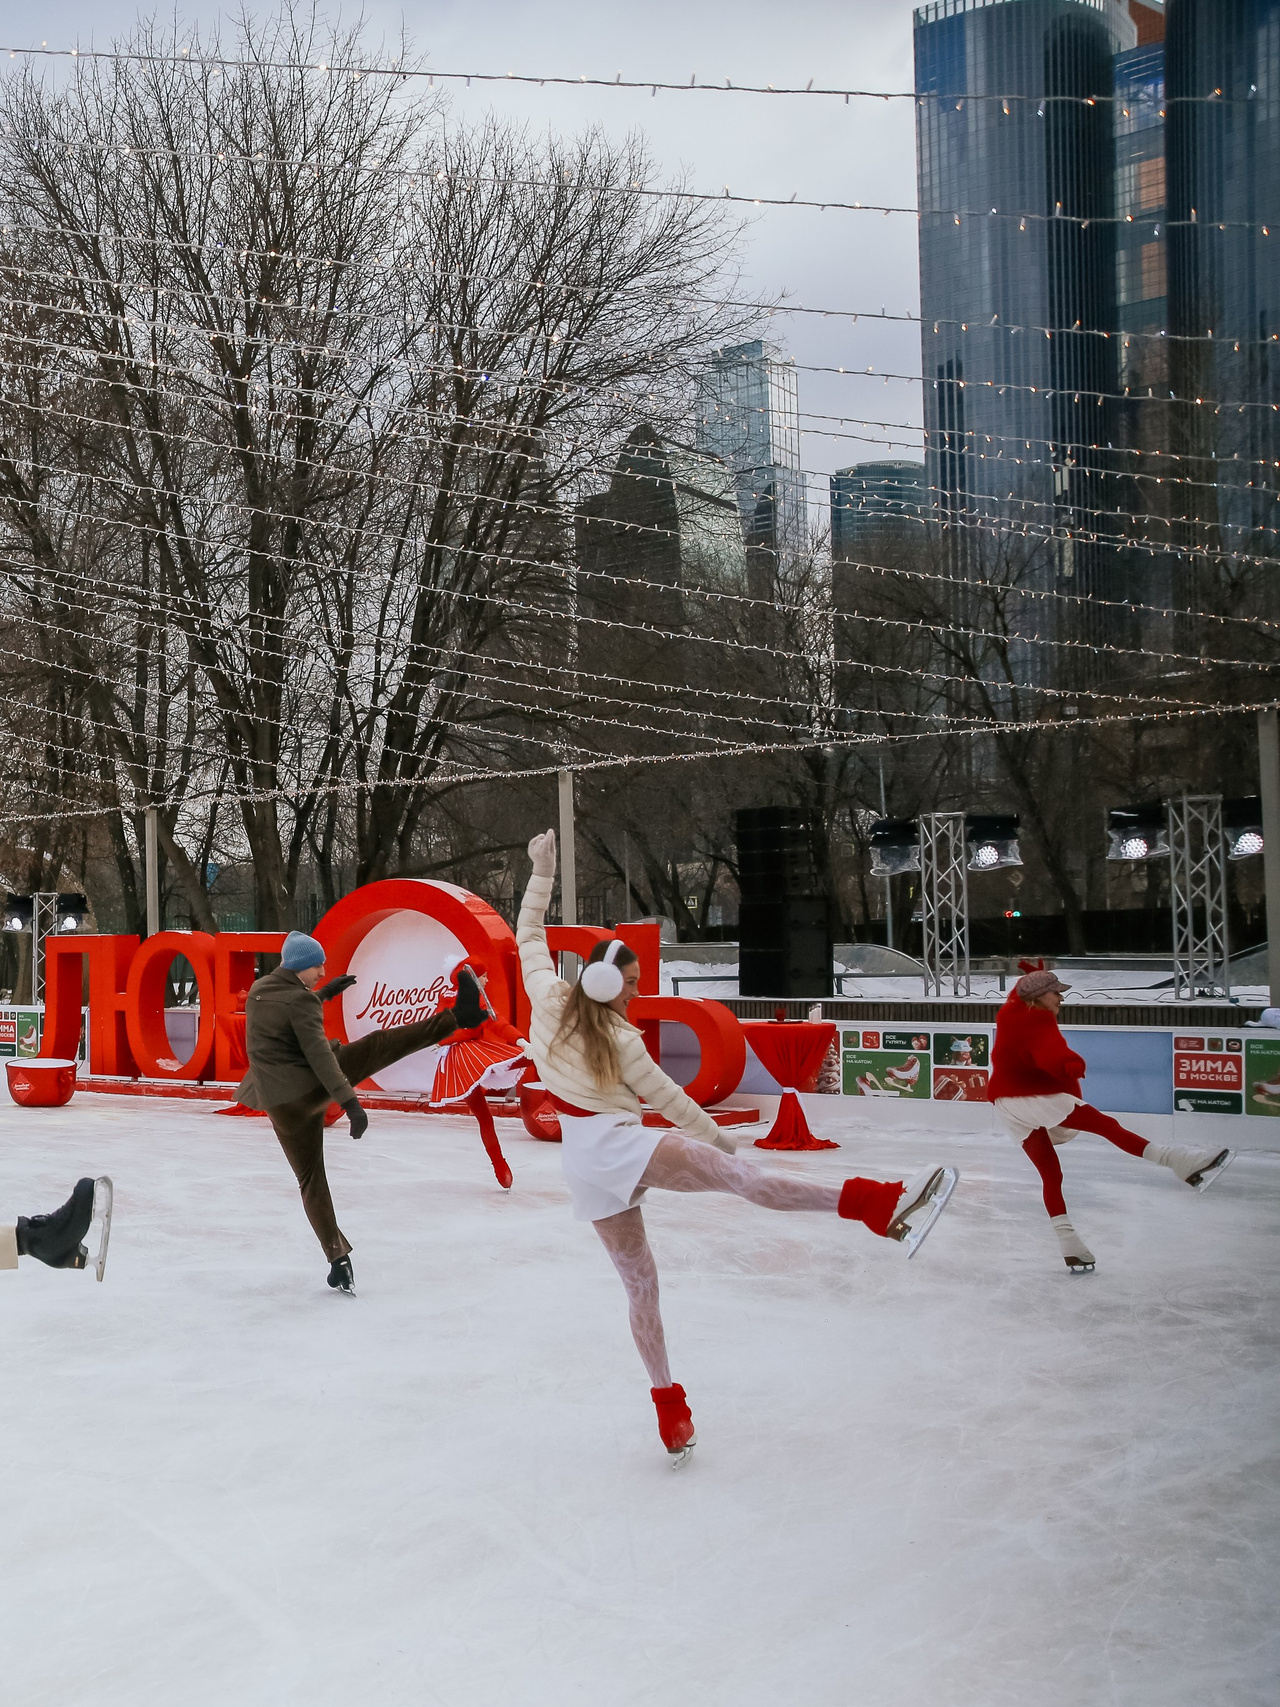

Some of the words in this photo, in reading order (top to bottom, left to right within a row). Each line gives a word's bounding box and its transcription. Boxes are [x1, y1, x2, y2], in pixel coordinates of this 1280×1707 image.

[1179, 1059, 1238, 1073] ЗИМА
[1179, 1072, 1187, 1080] В
[1190, 1073, 1238, 1082] МОСКВЕ
